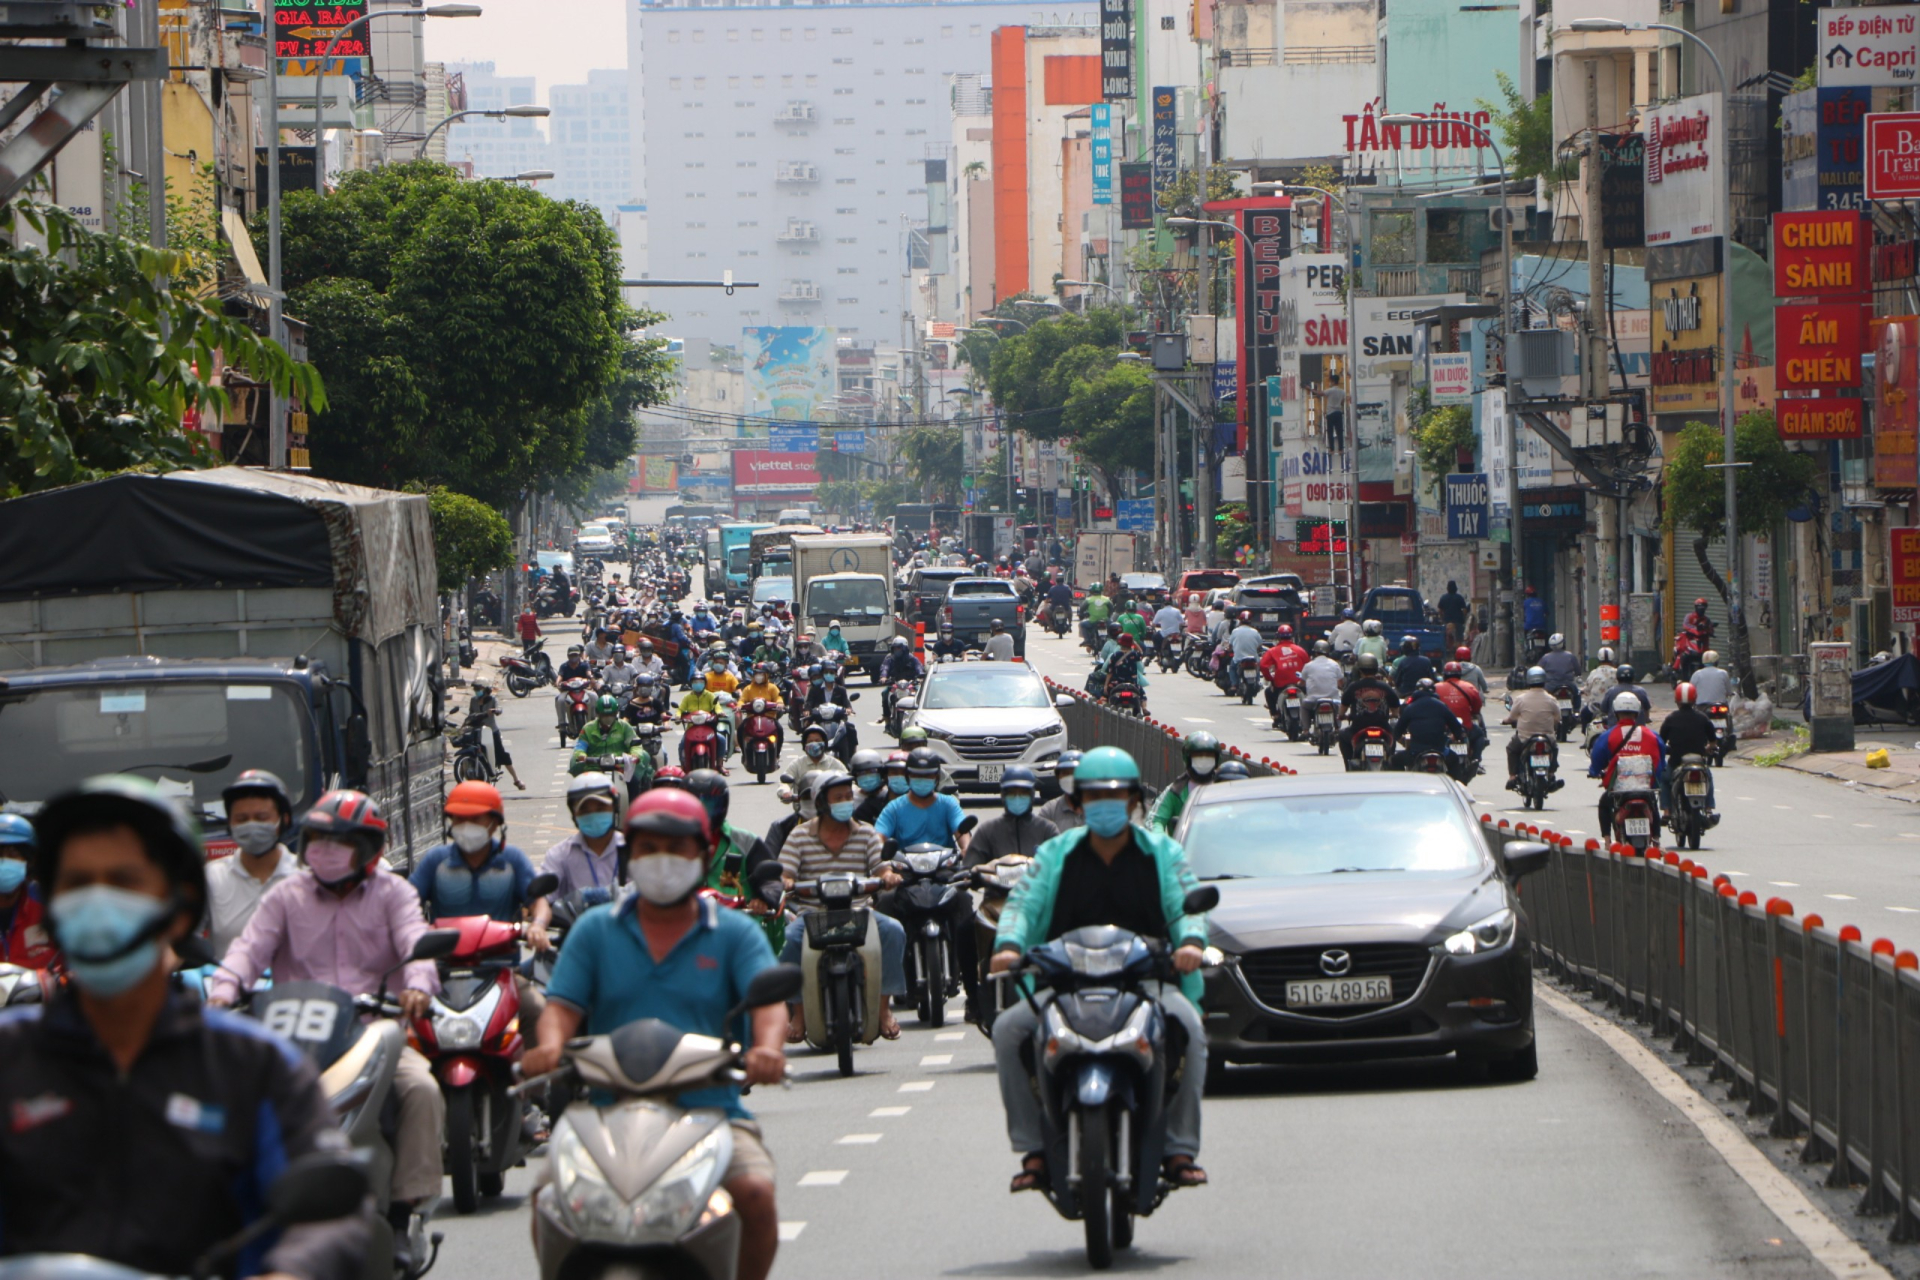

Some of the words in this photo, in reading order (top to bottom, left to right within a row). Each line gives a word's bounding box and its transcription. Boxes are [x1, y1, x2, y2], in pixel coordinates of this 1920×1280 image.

[274, 10, 313, 25] GIA
[317, 5, 360, 25] BẢO
[1828, 14, 1854, 37] BẾP
[1858, 14, 1892, 39] ĐIỆN
[1896, 13, 1916, 34] TỪ
[1856, 45, 1916, 71] Capri
[1103, 77, 1128, 94] LONG
[1892, 68, 1916, 80] Italy
[1823, 89, 1867, 125] BẾP
[1343, 96, 1402, 151] TẤN
[1410, 102, 1491, 150] DŨNG
[1829, 132, 1858, 163] TỪ
[69, 207, 92, 216] 248
[1827, 192, 1863, 210] 345
[1783, 221, 1853, 247] CHUM
[1786, 256, 1852, 288] SÀNH
[1304, 313, 1347, 346] SÀN
[1800, 312, 1838, 345] ẤM
[1363, 333, 1413, 356] SÀN
[1434, 368, 1445, 382] AN
[1447, 366, 1469, 384] DƯỢC
[1786, 351, 1850, 383] CHÉN
[1783, 404, 1825, 433] GIẢM
[1826, 408, 1856, 433] 30%
[750, 461, 793, 471] viettel
[1449, 475, 1487, 506] THUỐC
[1458, 508, 1479, 535] TÂY
[1895, 609, 1911, 620] 351
[1290, 980, 1388, 1005] 51G-489.56
